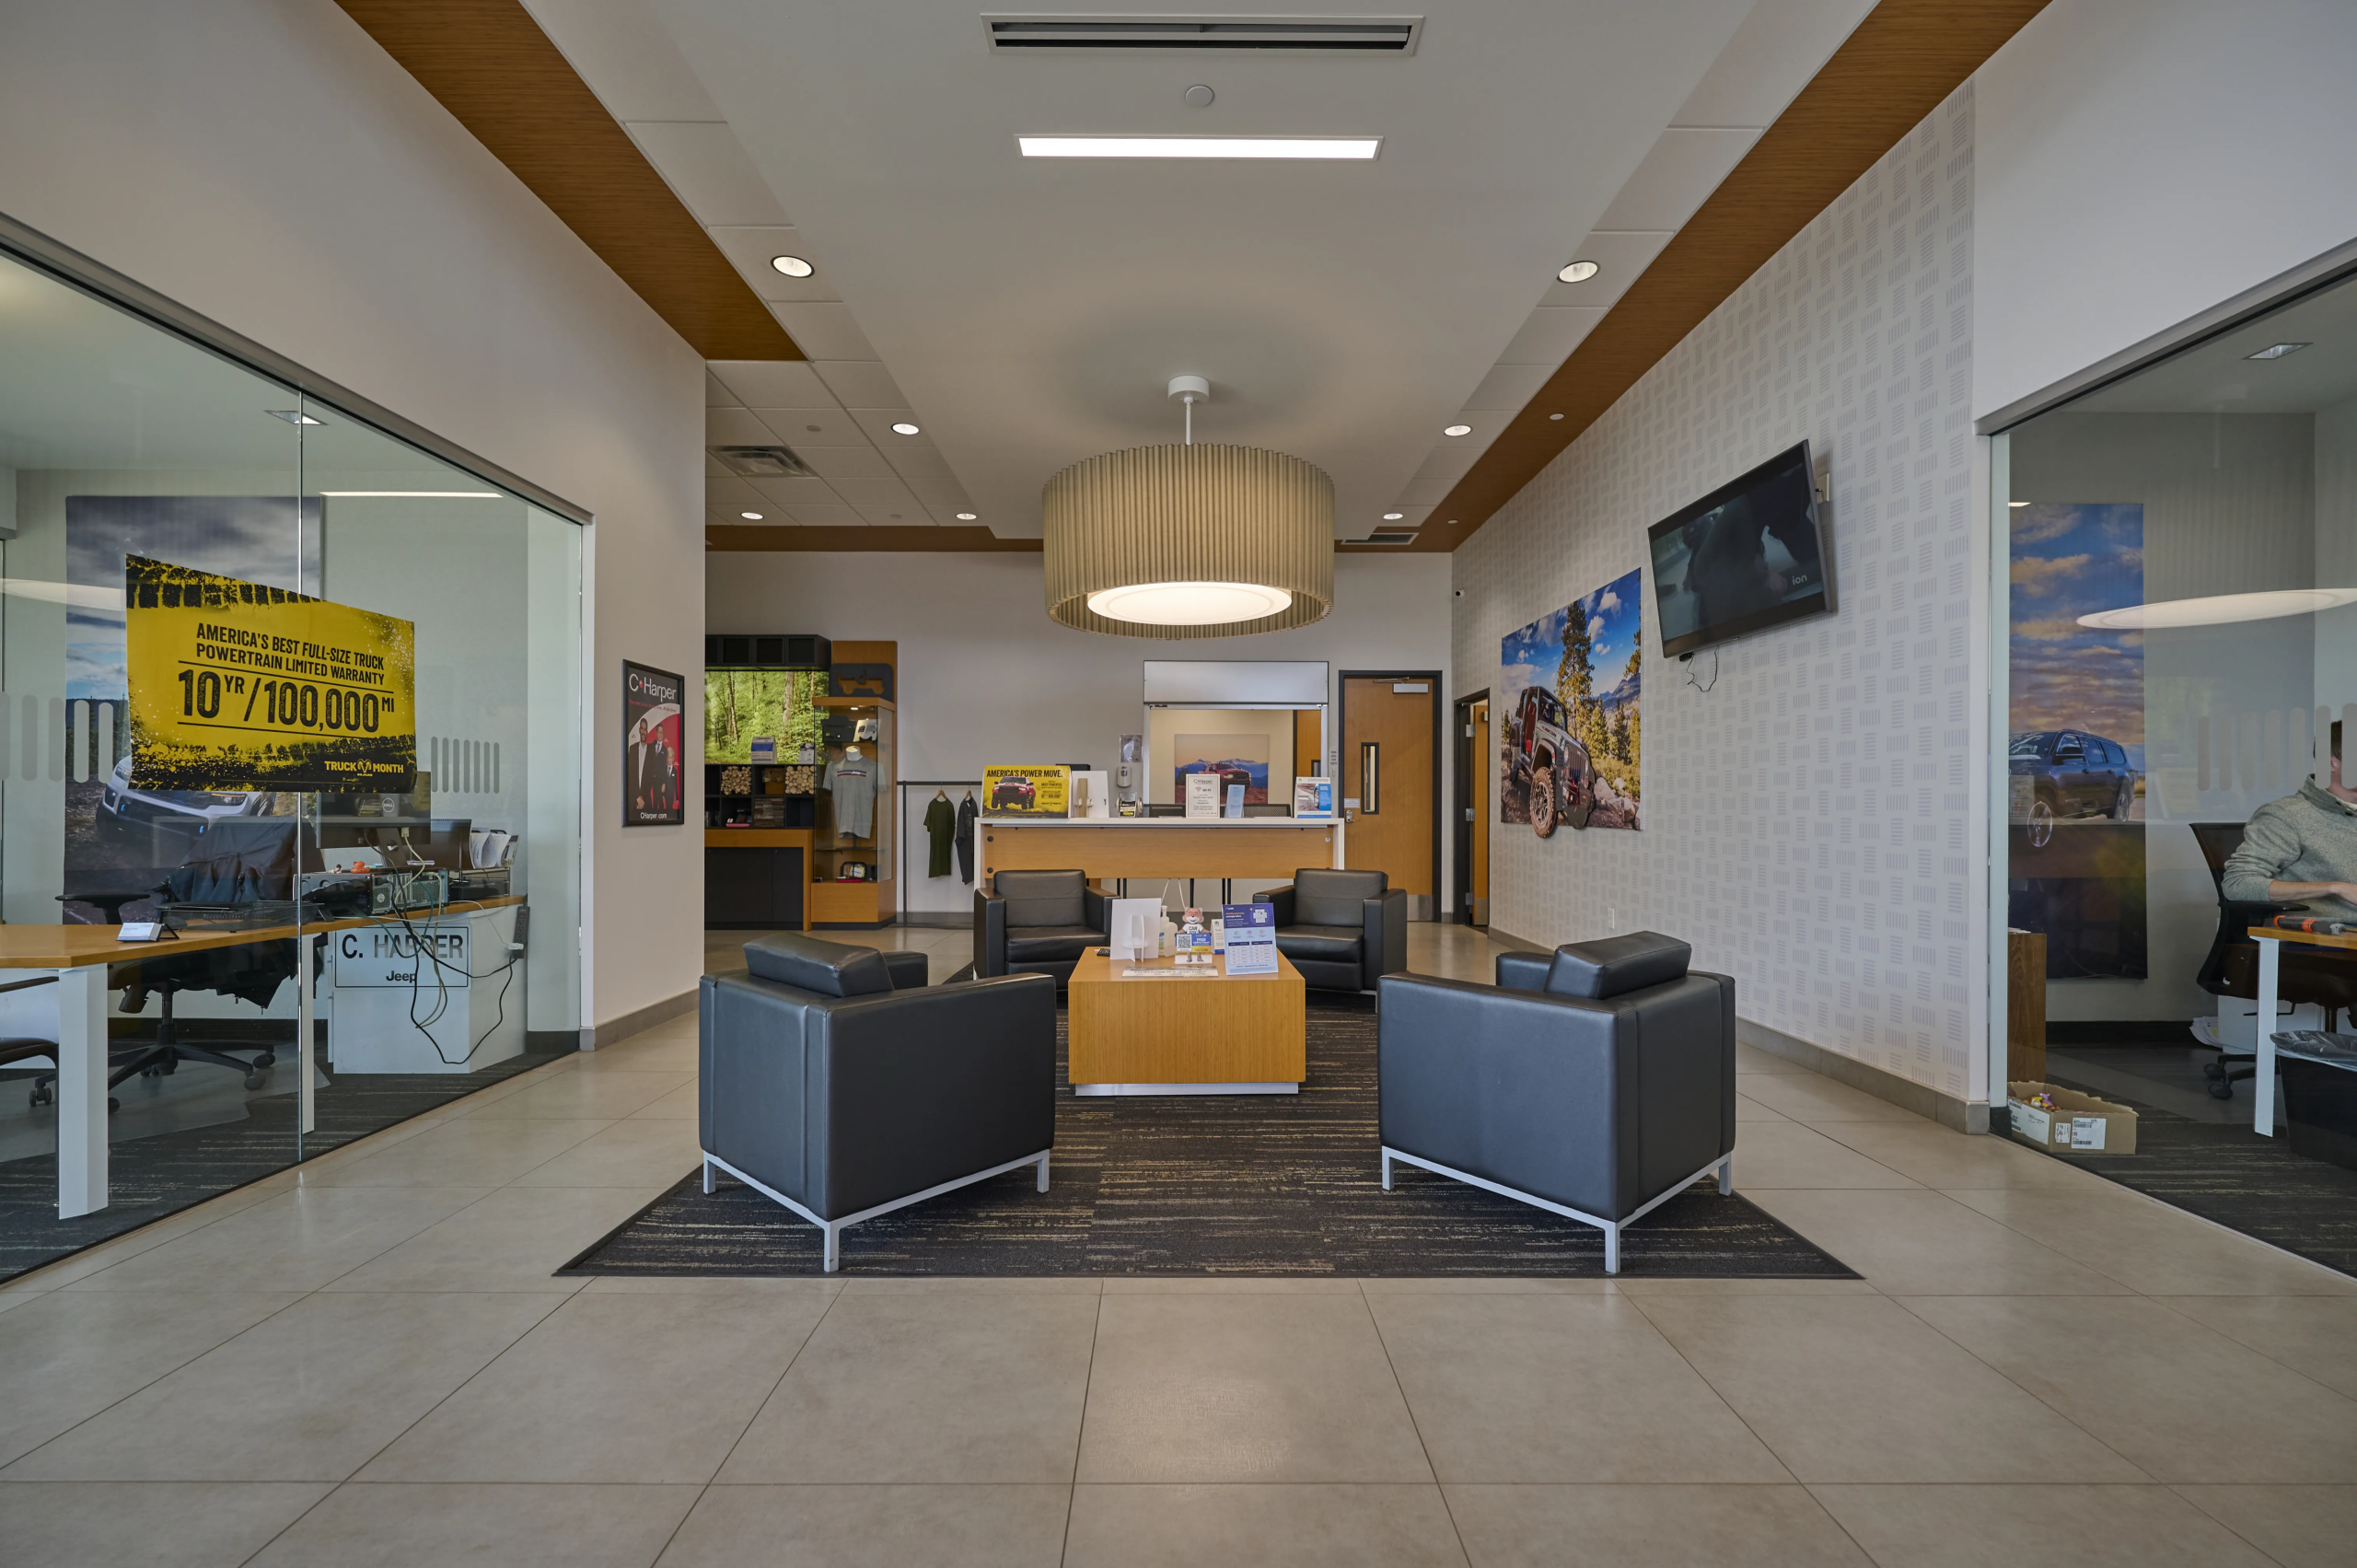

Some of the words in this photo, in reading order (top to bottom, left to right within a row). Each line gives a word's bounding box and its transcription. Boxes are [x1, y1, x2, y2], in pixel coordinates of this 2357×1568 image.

[1792, 575, 1807, 586] ion
[196, 622, 269, 650] AMERICA'S
[273, 636, 300, 655] BEST
[301, 642, 351, 665] FULL-SIZE
[354, 652, 384, 670] TRUCK
[196, 643, 283, 669] POWERTRAIN
[285, 657, 328, 677] LIMITED
[331, 666, 385, 685] WARRANTY
[324, 761, 357, 772] TRUCK
[372, 763, 404, 773] MONTH
[342, 934, 364, 959] C.
